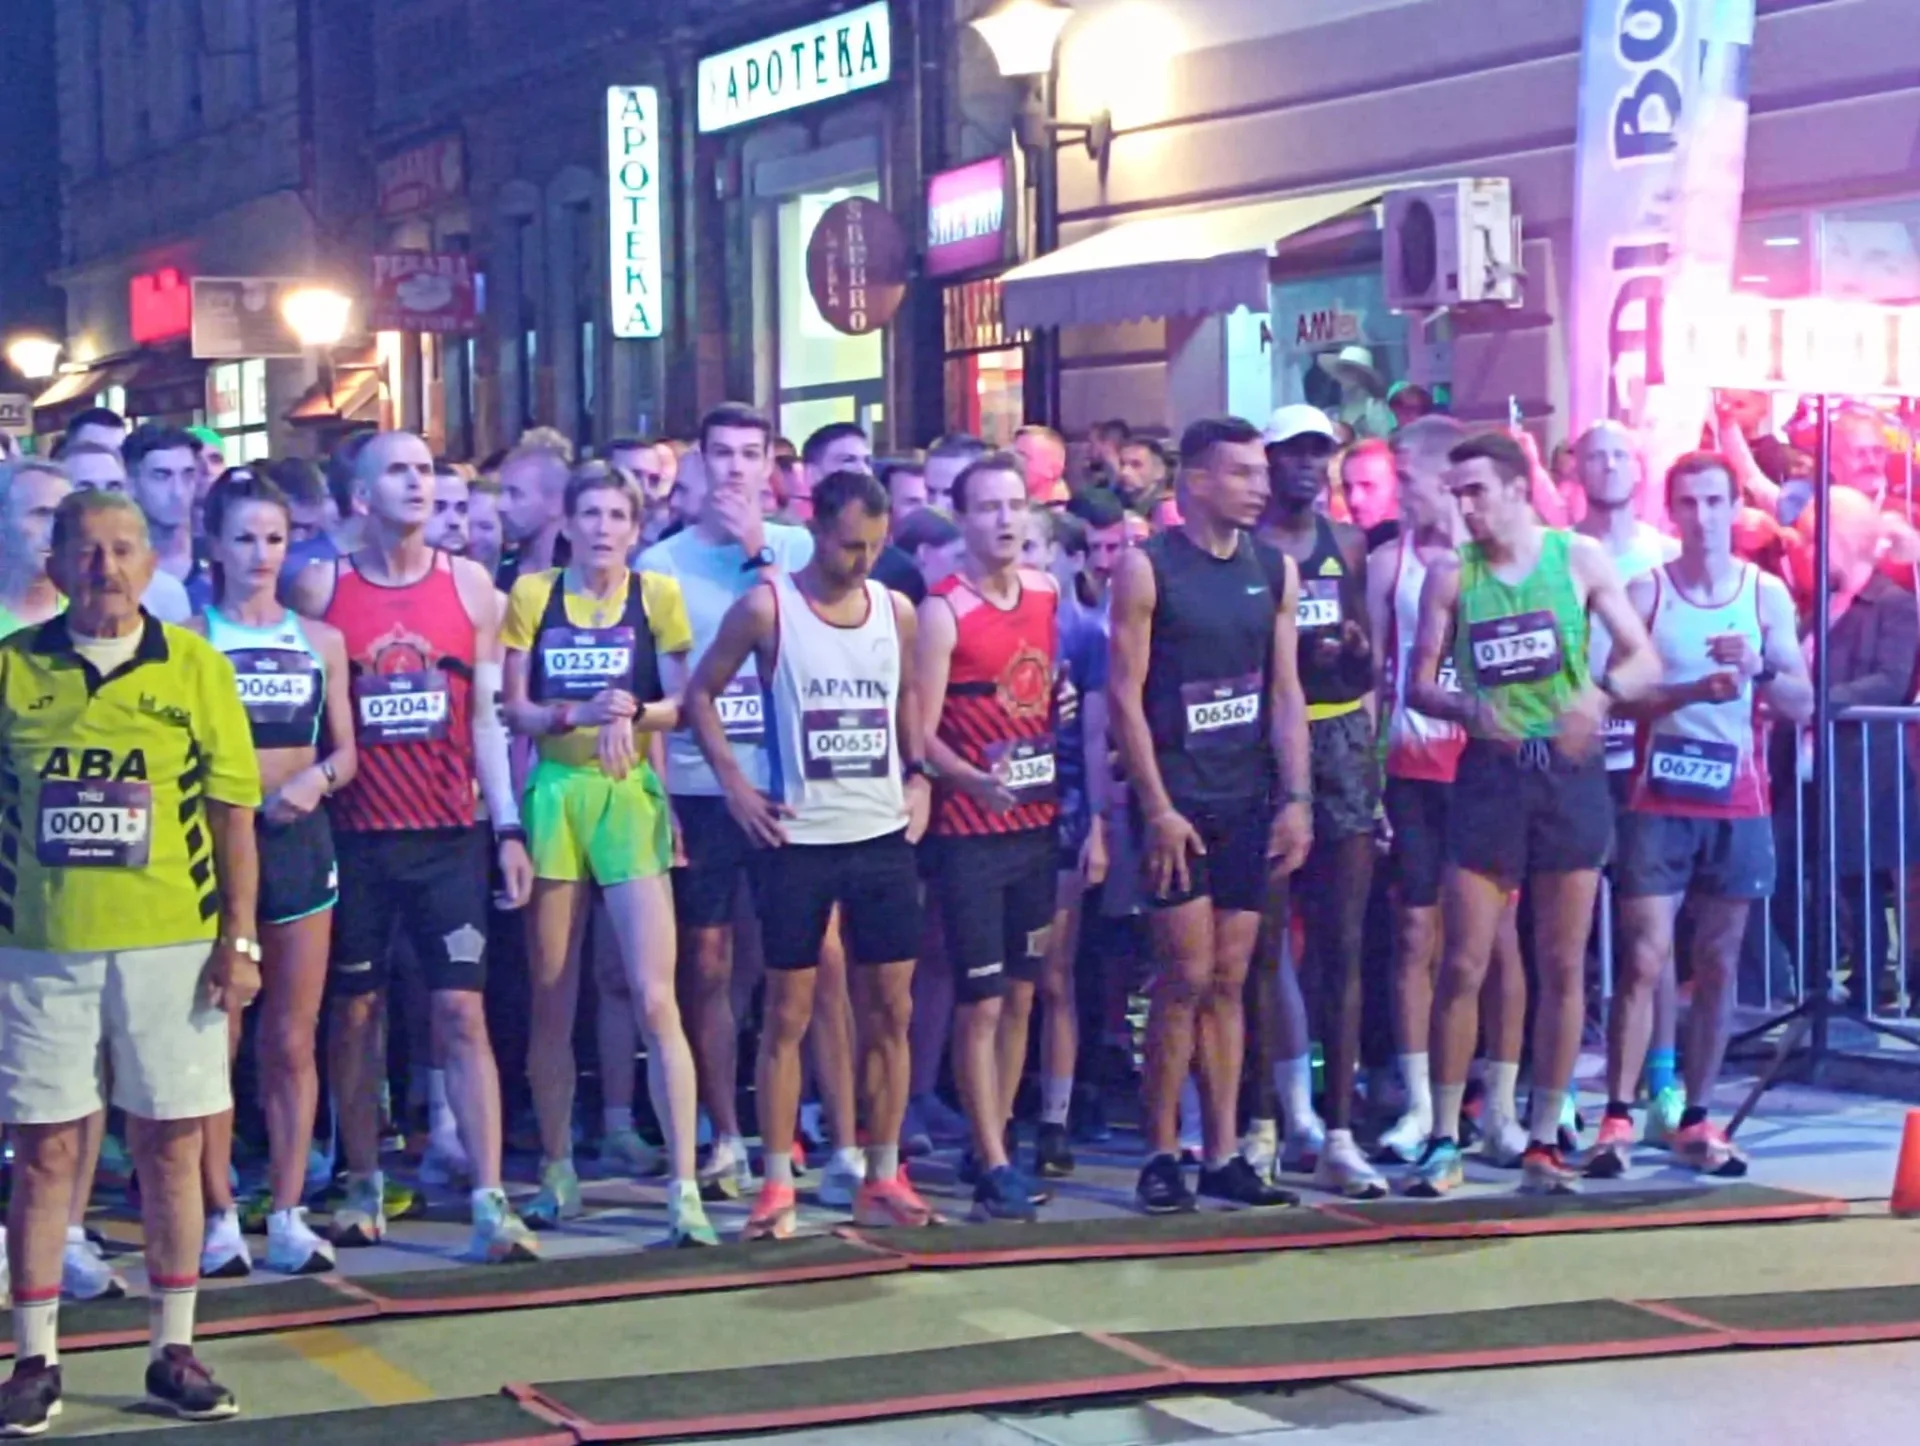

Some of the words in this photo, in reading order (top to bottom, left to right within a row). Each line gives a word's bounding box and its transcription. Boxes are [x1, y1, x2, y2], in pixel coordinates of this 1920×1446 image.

[727, 20, 878, 111] APOTEKA
[619, 90, 650, 331] APOTEKA
[1480, 636, 1537, 661] 0179
[552, 652, 611, 671] 0252
[368, 697, 430, 718] 0204
[1194, 702, 1246, 725] 0656
[816, 733, 873, 752] 0065
[39, 747, 149, 780] ABA
[1659, 760, 1714, 780] 0677
[51, 812, 120, 834] 0001
